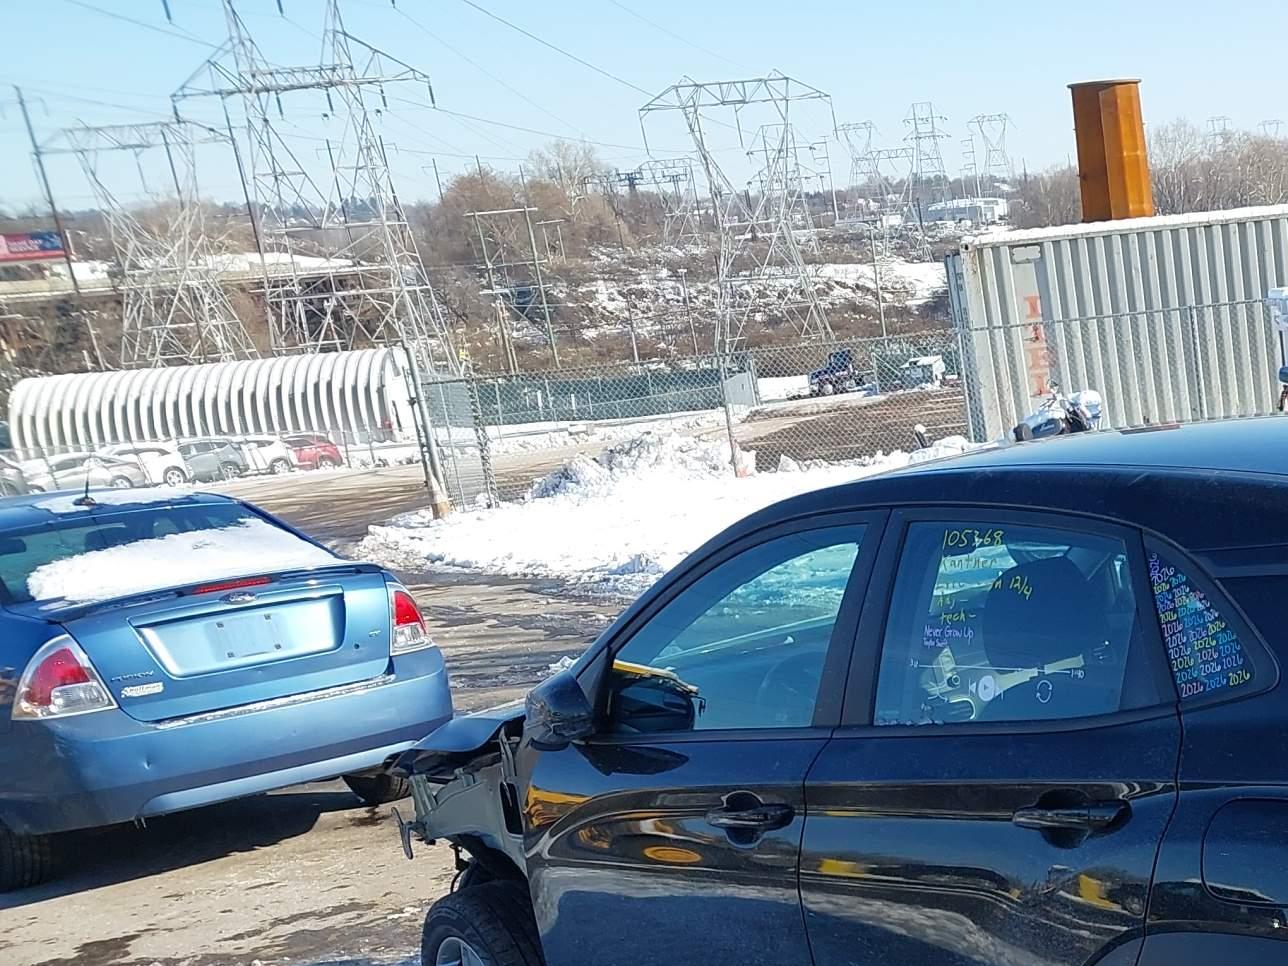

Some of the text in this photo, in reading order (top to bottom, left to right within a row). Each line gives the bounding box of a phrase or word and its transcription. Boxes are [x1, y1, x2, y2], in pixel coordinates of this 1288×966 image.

[942, 529, 1004, 547] 105368
[1152, 567, 1175, 586] 2026
[1009, 576, 1033, 600] 12/4
[940, 608, 966, 625] tech
[1161, 611, 1177, 624] 2026
[1162, 621, 1184, 637] 2026
[1184, 615, 1204, 628] 2026
[924, 625, 974, 645] Never Grow Up
[1167, 621, 1226, 648] 2026 2026 2026
[1169, 646, 1192, 659] 2026
[1194, 637, 1217, 651] 2026
[1172, 642, 1241, 672] 2026 2026 2026
[1176, 654, 1243, 684] 2026 2026 2026
[1181, 669, 1250, 698] 2026 2026 2026
